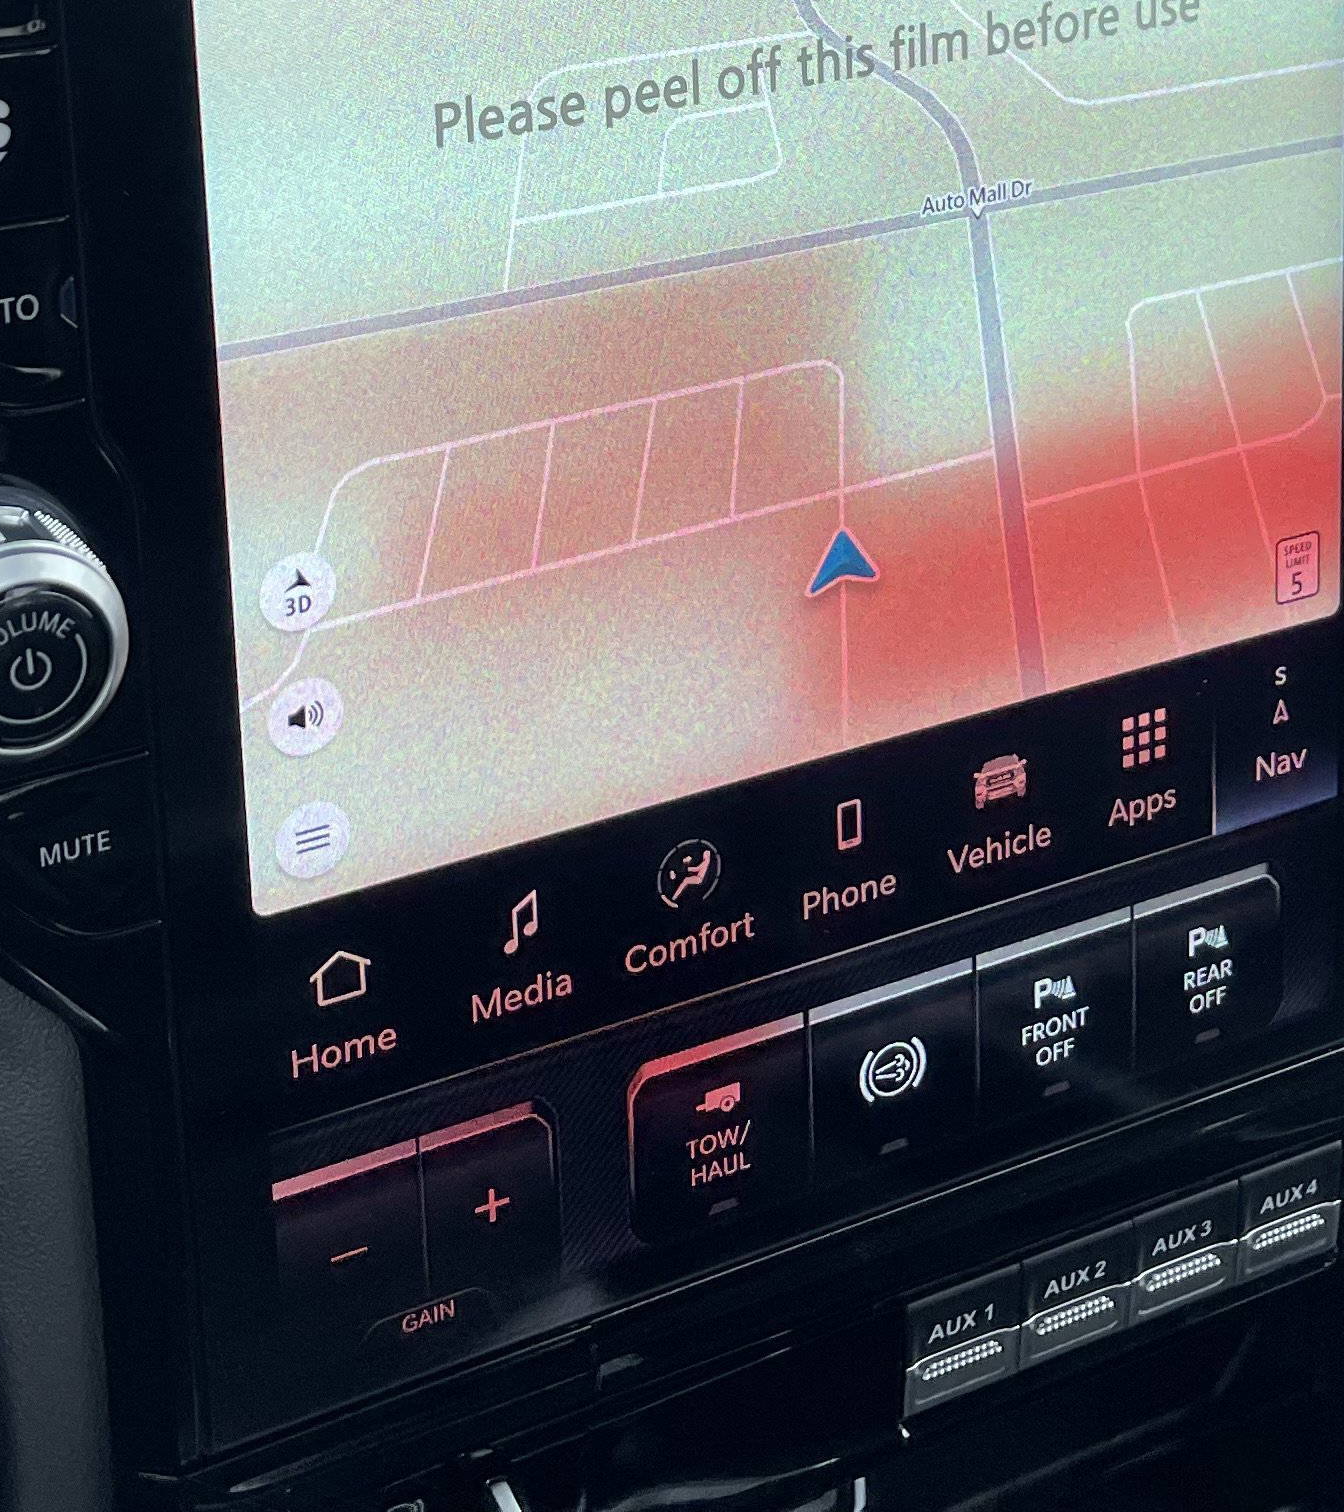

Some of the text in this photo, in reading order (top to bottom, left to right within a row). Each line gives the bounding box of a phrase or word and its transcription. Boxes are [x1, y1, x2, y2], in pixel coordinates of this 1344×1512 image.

[434, 91, 586, 148] Please
[605, 58, 700, 129] peel
[717, 44, 782, 99] off
[797, 34, 876, 87] this
[889, 22, 969, 71] film
[987, 1, 1120, 56] before
[921, 179, 1032, 215] Auto Mall Dr
[1283, 541, 1312, 557] SPEED
[1285, 553, 1311, 569] LIMIT
[1291, 571, 1303, 596] 5
[285, 594, 312, 617] 3D
[1274, 666, 1288, 686] S
[1255, 748, 1308, 782] Nav
[1108, 788, 1178, 828] Apps
[39, 829, 112, 868] MUTE
[947, 823, 1053, 874] Vehicle
[802, 873, 898, 921] Phone
[624, 911, 756, 974] Comfort
[1183, 958, 1234, 991] REAR
[470, 970, 574, 1024] Media
[1189, 985, 1228, 1014] OFF
[1021, 1006, 1090, 1046] FRONT
[291, 1026, 398, 1079] Home
[1035, 1037, 1076, 1067] OFF
[685, 1119, 752, 1160] TOW/
[690, 1150, 752, 1188] HAUL
[1259, 1178, 1319, 1216] AUX 4
[1151, 1219, 1214, 1257] AUX 3
[1043, 1259, 1108, 1300] AUX 2
[401, 1299, 456, 1334] GAIN
[927, 1302, 996, 1345] AUX 1
